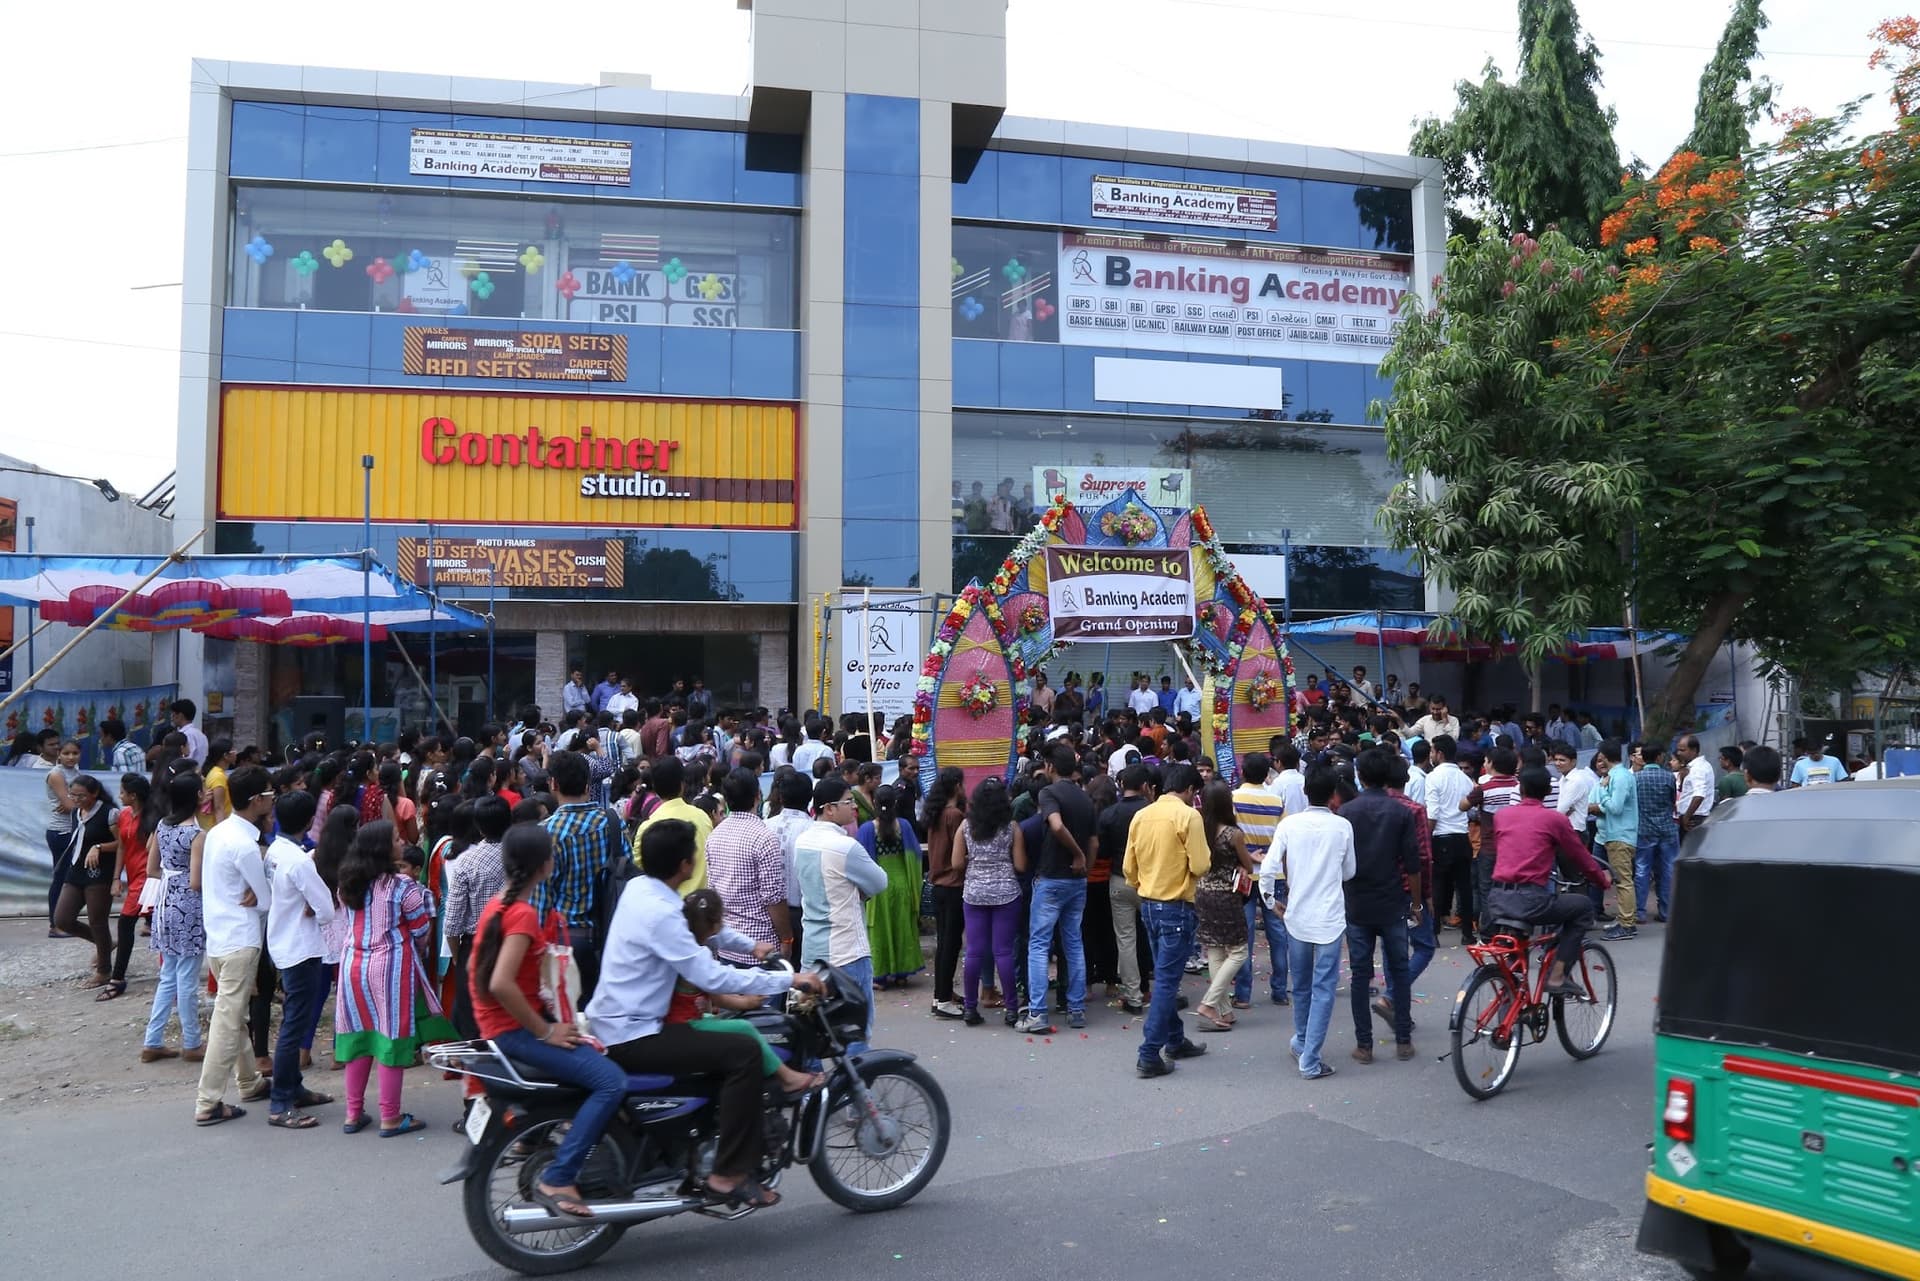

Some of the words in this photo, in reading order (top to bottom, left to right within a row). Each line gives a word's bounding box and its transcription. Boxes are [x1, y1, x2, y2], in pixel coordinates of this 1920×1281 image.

[424, 157, 477, 174] Banking
[481, 163, 537, 177] Academy
[1111, 187, 1169, 208] Banking
[1173, 195, 1234, 213] Academy
[1076, 235, 1115, 247] Premier
[1118, 238, 1161, 250] Institute
[1163, 241, 1178, 251] for
[1180, 244, 1236, 256] Preparation
[1240, 249, 1250, 257] of
[1252, 248, 1265, 257] All
[1268, 250, 1296, 262] Types
[1310, 254, 1365, 266] Competitive
[1334, 267, 1340, 276] A
[1341, 269, 1355, 279] Way
[1357, 270, 1368, 279] For
[586, 271, 650, 297] BANK
[686, 276, 746, 299] GSC
[1105, 255, 1250, 304] Banking
[1259, 273, 1407, 314] Academy
[600, 304, 637, 323] PSI
[1072, 298, 1090, 309] IBPS
[1104, 300, 1118, 310] SBI
[1130, 302, 1143, 312] RBI
[1155, 304, 1176, 314] GPSC
[1187, 306, 1203, 317] SSC
[1246, 310, 1259, 321] PSI
[422, 327, 448, 335] VASES
[1069, 315, 1093, 326] BASIC
[1094, 317, 1127, 329] ENGLISH
[1174, 322, 1207, 333] RAILWAY
[1209, 324, 1229, 335] EXAM
[1237, 326, 1255, 337] POST
[1257, 327, 1282, 338] OFFICE
[1335, 332, 1368, 344] DISTANCE
[1316, 315, 1336, 325] CMAT
[1352, 317, 1377, 328] TET/TAT
[427, 340, 467, 350] MIRRORS
[474, 338, 514, 348] MIRRORS
[521, 333, 562, 348] SOFA
[568, 335, 610, 351] SETS
[426, 358, 468, 376] BED
[476, 359, 531, 379] SETS
[421, 417, 679, 472] Container
[581, 472, 690, 497] studio...
[1080, 473, 1146, 495] Supreme
[450, 545, 488, 559] SETS
[476, 538, 502, 547] PHOTO
[504, 539, 536, 547] FRAMES
[487, 548, 576, 573] VASES
[575, 556, 606, 566] CUSHI
[1058, 551, 1155, 575] Welcome
[1161, 556, 1182, 576] to
[503, 572, 543, 586] SOFA
[548, 572, 588, 587] SETS
[1085, 588, 1138, 609] Banking
[1080, 619, 1122, 631] Grand
[1125, 619, 1178, 634] Opening
